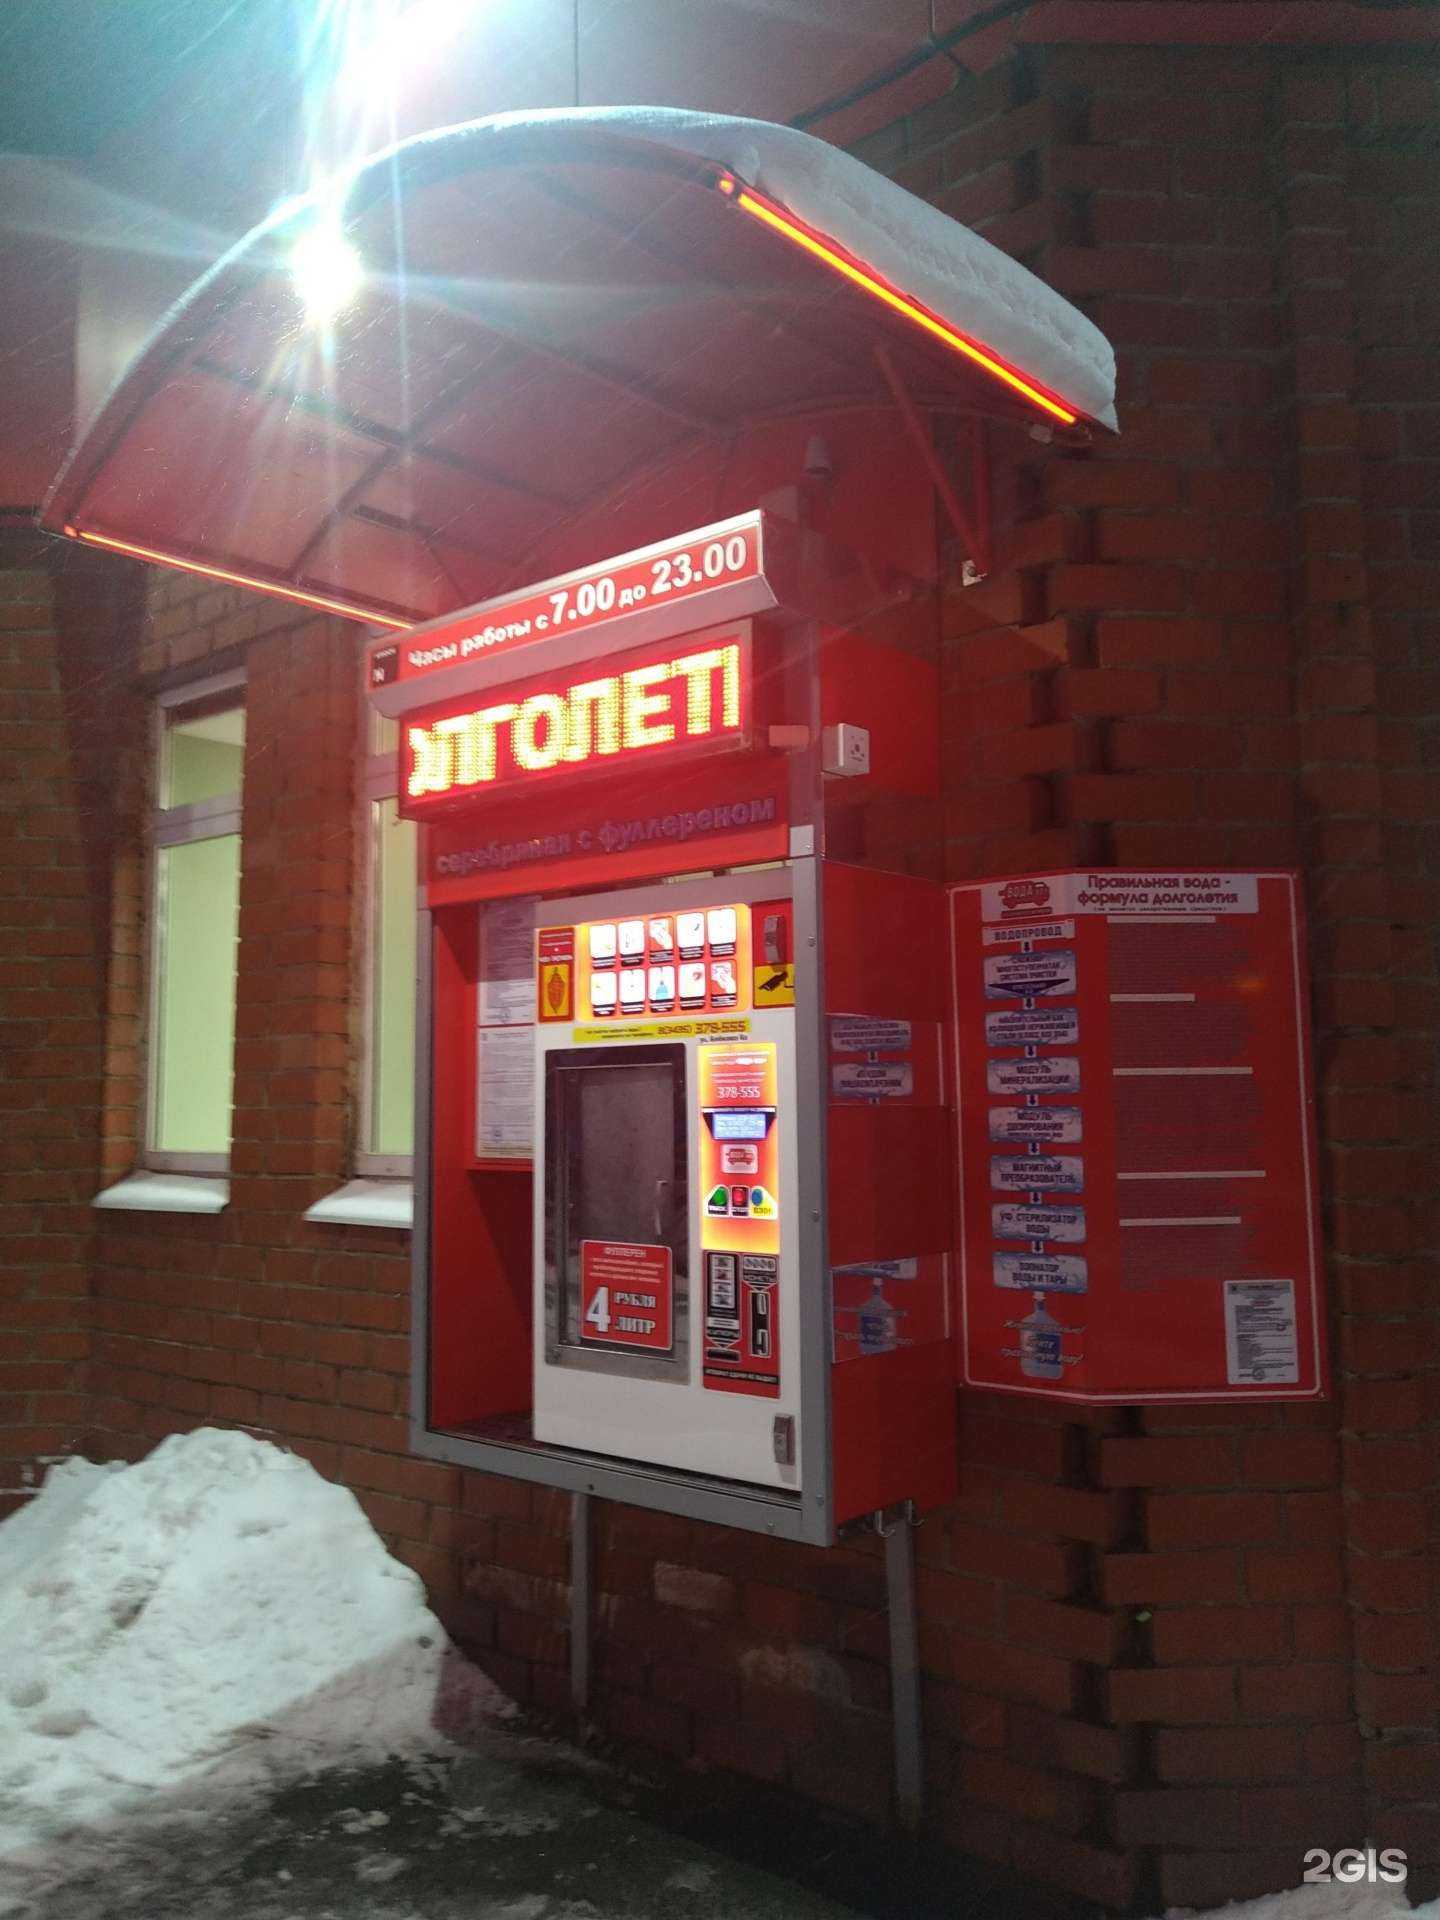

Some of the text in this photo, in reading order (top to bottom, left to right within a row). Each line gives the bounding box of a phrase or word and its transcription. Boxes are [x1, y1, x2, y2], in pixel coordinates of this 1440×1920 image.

[409, 536, 748, 668] Часы работы с 7.00 до 23.00
[577, 830, 592, 850] с
[599, 798, 775, 852] фуллереном
[1088, 875, 1180, 890] Правильная
[1184, 877, 1220, 890] вода
[1007, 885, 1034, 898] ВОДА
[1078, 891, 1239, 906] формула долголетия
[994, 926, 1063, 941] ВОДОПРОВОД
[1013, 1161, 1062, 1172] МАГНИТНЫЙ
[1001, 1173, 1076, 1184] ПРЕОБРАЗОВАТЕЛЬ
[1016, 1212, 1077, 1224] СТЕРИЛИЗАТОР
[586, 1286, 611, 1333] 4
